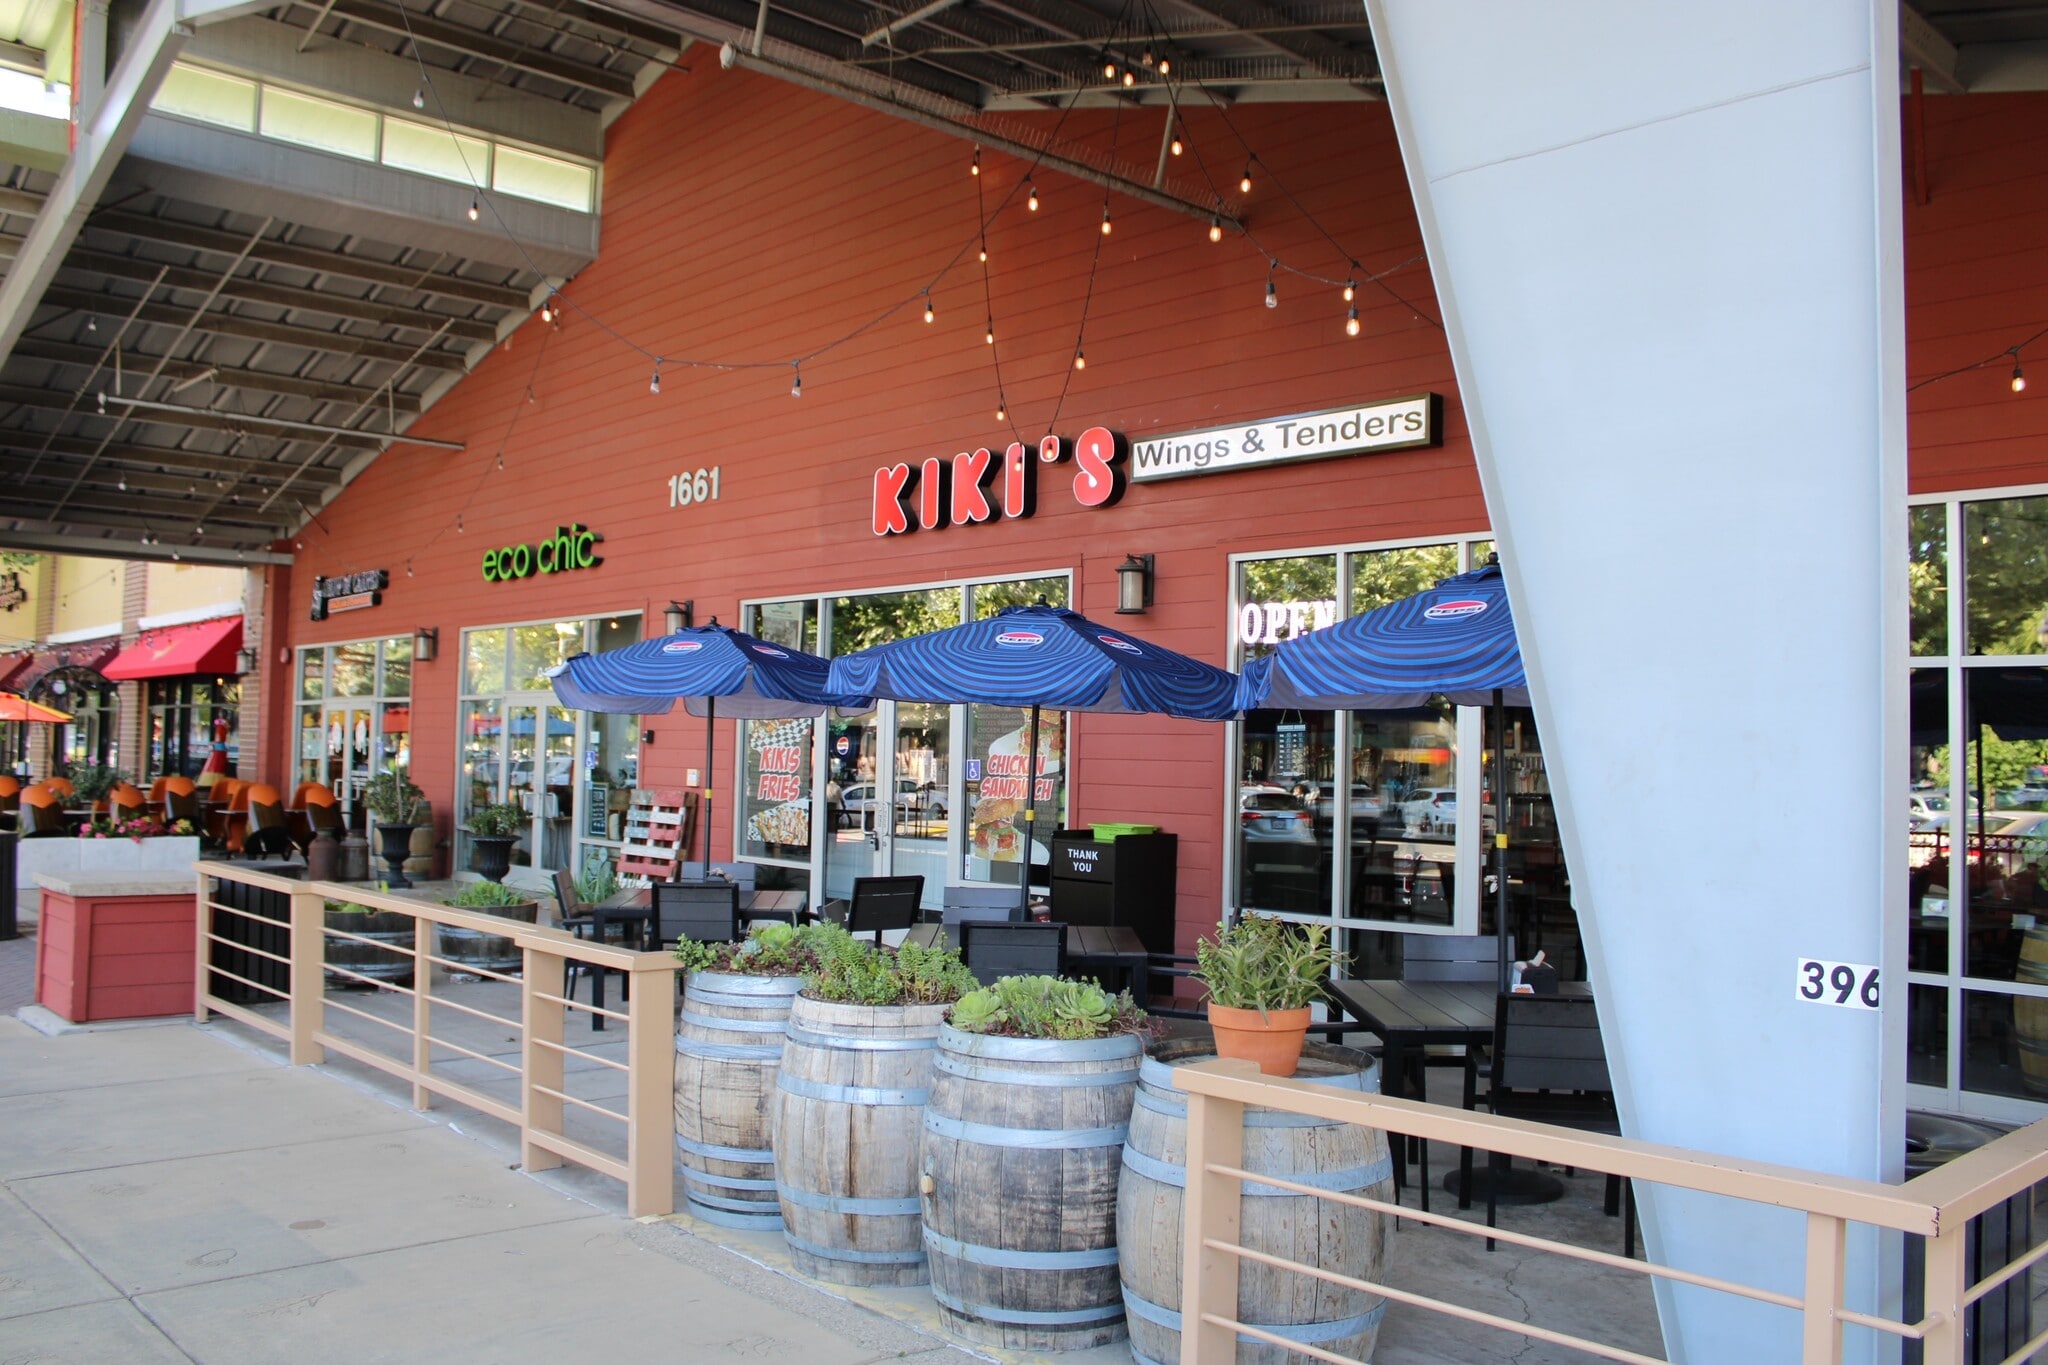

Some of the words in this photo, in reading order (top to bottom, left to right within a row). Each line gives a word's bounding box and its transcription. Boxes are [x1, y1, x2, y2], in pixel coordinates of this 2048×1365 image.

[1136, 438, 1230, 467] Wings
[1241, 428, 1265, 454] &
[1275, 410, 1424, 449] Tenders
[668, 465, 720, 508] 1661
[872, 426, 1115, 536] KIKI'S
[482, 548, 531, 582] eco
[537, 522, 596, 575] chic
[1239, 600, 1337, 645] OPEN
[759, 745, 801, 773] KIKIS
[987, 753, 1048, 776] CHICKN
[757, 773, 801, 802] FRIES
[980, 776, 1054, 801] SANDWCH
[1067, 848, 1098, 861] THANK
[1072, 861, 1092, 873] YOU
[1800, 961, 1880, 1008] 396
